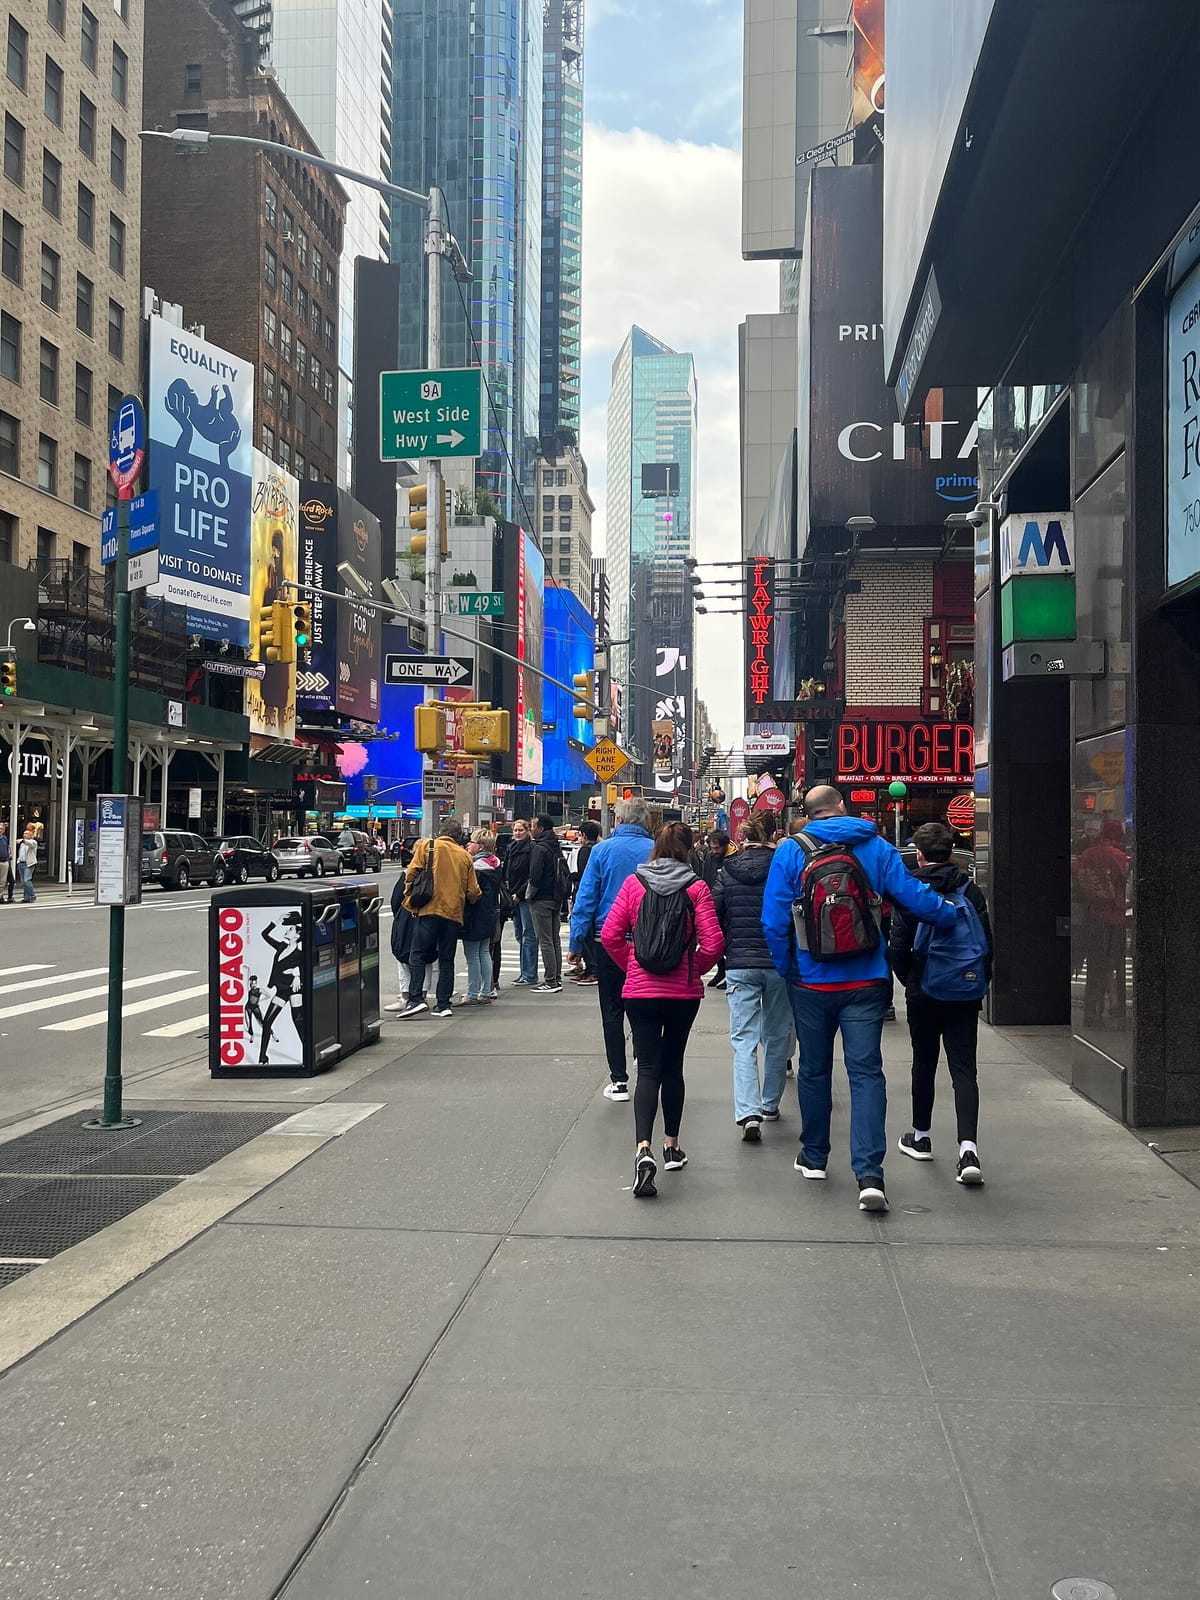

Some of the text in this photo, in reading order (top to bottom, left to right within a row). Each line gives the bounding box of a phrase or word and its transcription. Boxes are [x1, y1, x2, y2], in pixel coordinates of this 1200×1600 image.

[806, 145, 825, 159] Clear
[826, 129, 856, 149] Channel
[1182, 301, 1200, 334] CBR
[170, 338, 238, 382] EQUALITY
[423, 384, 439, 398] 9A
[392, 406, 470, 424] West Side
[396, 434, 428, 451] Hwy
[175, 462, 230, 509] PRO
[102, 511, 114, 534] M7
[174, 502, 229, 548] LIFE
[160, 554, 243, 586] VISIT TO DONATE
[314, 562, 323, 588] AWAY
[168, 584, 233, 607] DonateToProLife.com
[460, 595, 501, 612] W 49 St
[314, 622, 323, 644] JUST
[353, 612, 367, 634] FOR
[749, 556, 773, 703] PLAYWRIGHT
[206, 662, 241, 675] OUTFRONT
[399, 664, 461, 677] ONE WAY
[752, 705, 836, 720] TAVERN
[838, 724, 974, 773] BURGER
[8, 751, 64, 779] GIFTS
[853, 792, 874, 800] OPEN
[219, 908, 244, 1066] CHICAGO
